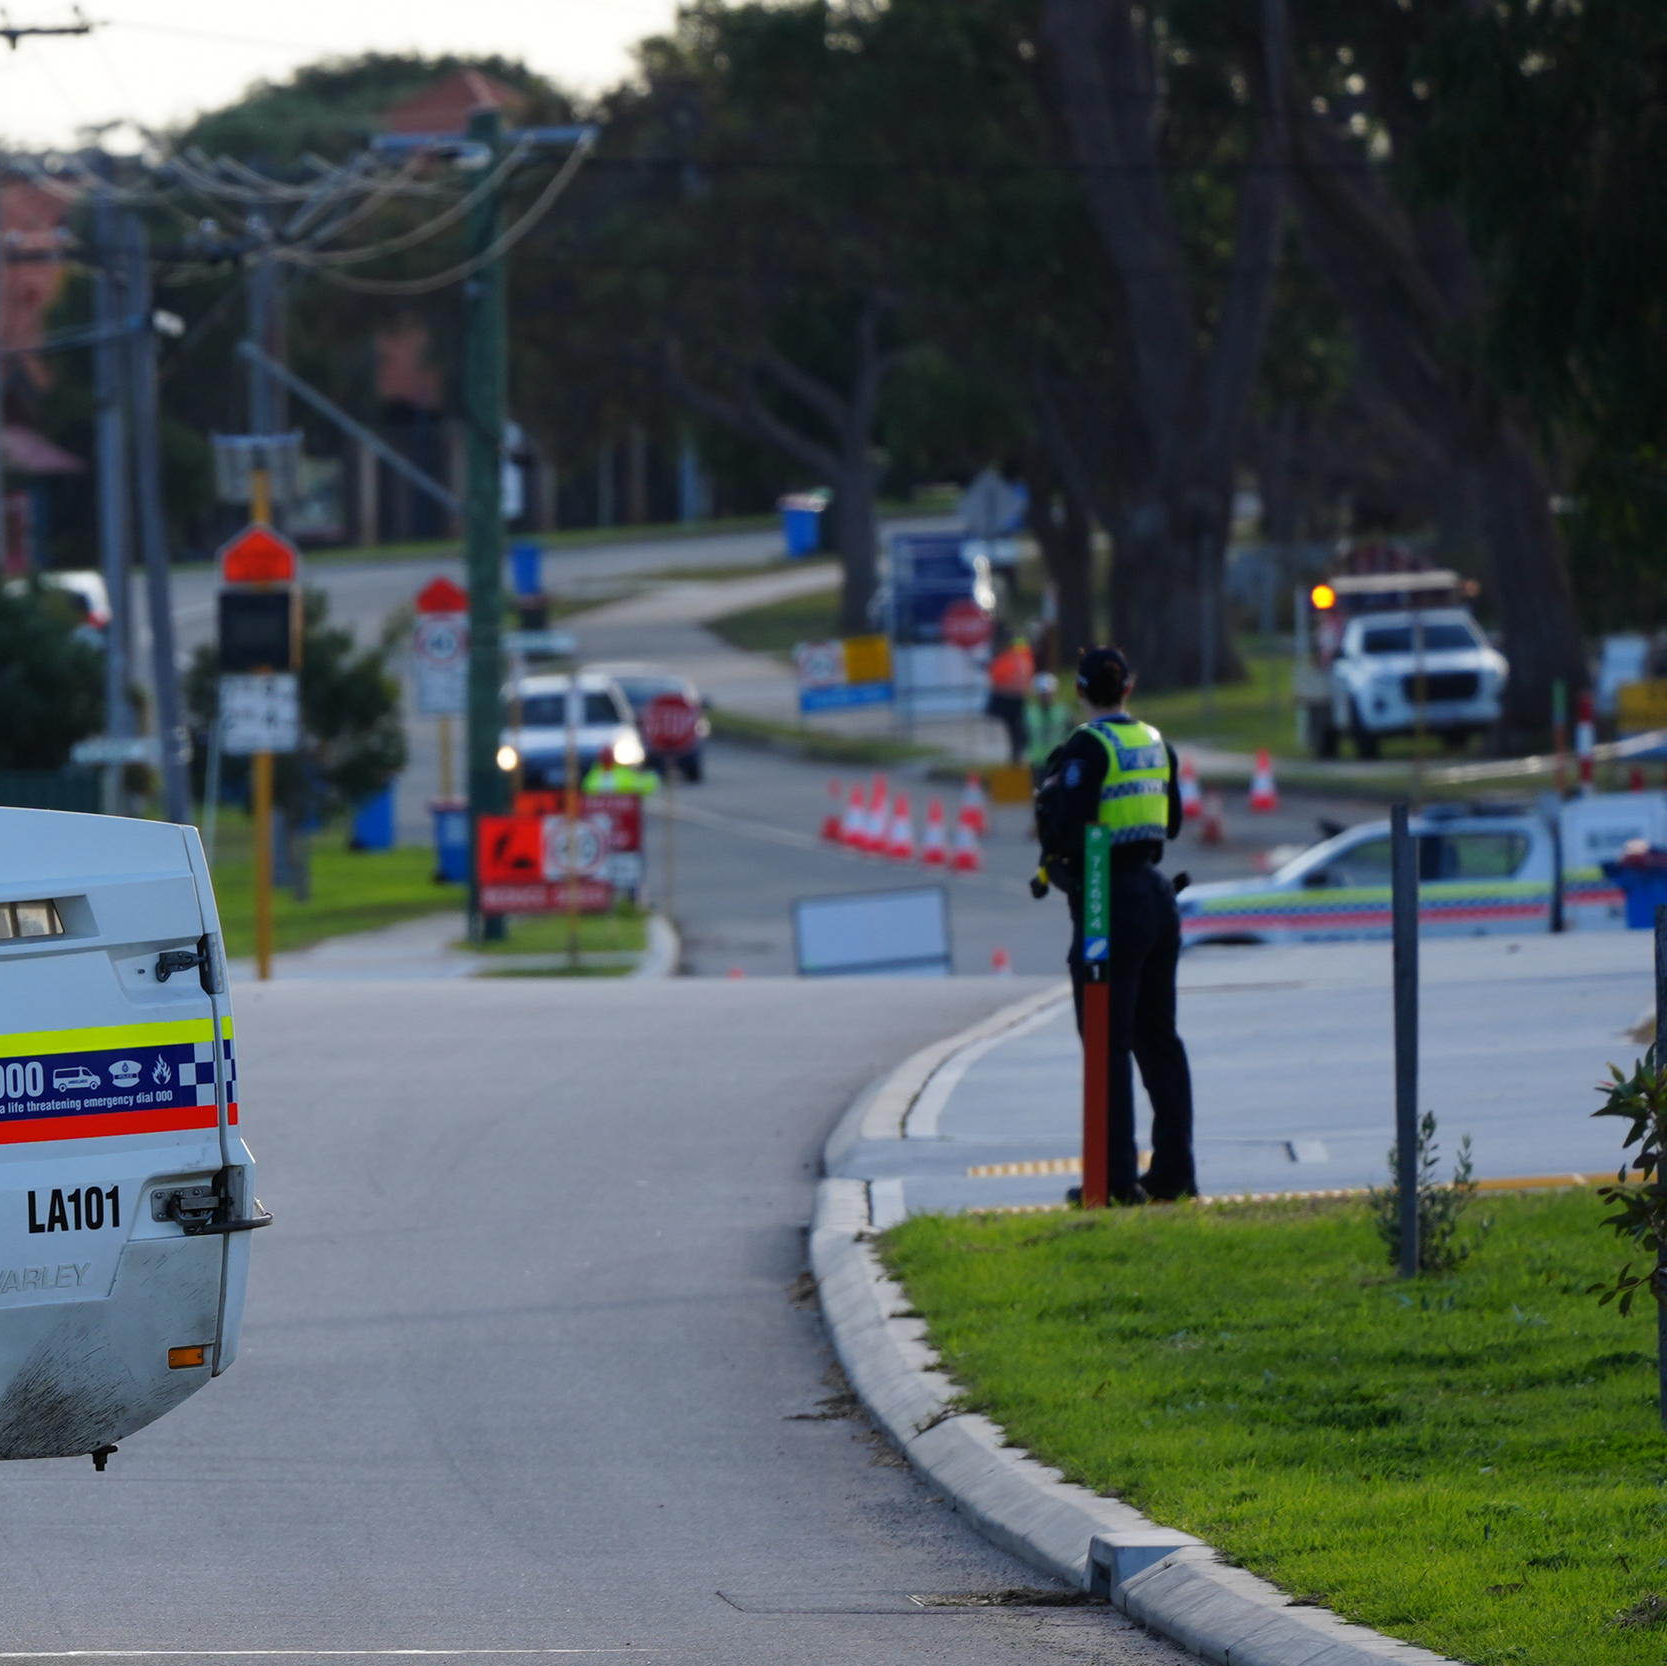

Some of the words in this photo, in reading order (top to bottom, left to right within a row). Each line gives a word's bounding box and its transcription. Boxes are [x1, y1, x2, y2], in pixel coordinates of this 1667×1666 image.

[0, 1105, 6, 1114] a
[8, 1100, 24, 1113] life
[26, 1098, 81, 1113] threatening
[83, 1095, 133, 1109] emergency
[136, 1091, 154, 1103] dial
[155, 1090, 173, 1101] 000
[27, 1185, 120, 1234] LA101
